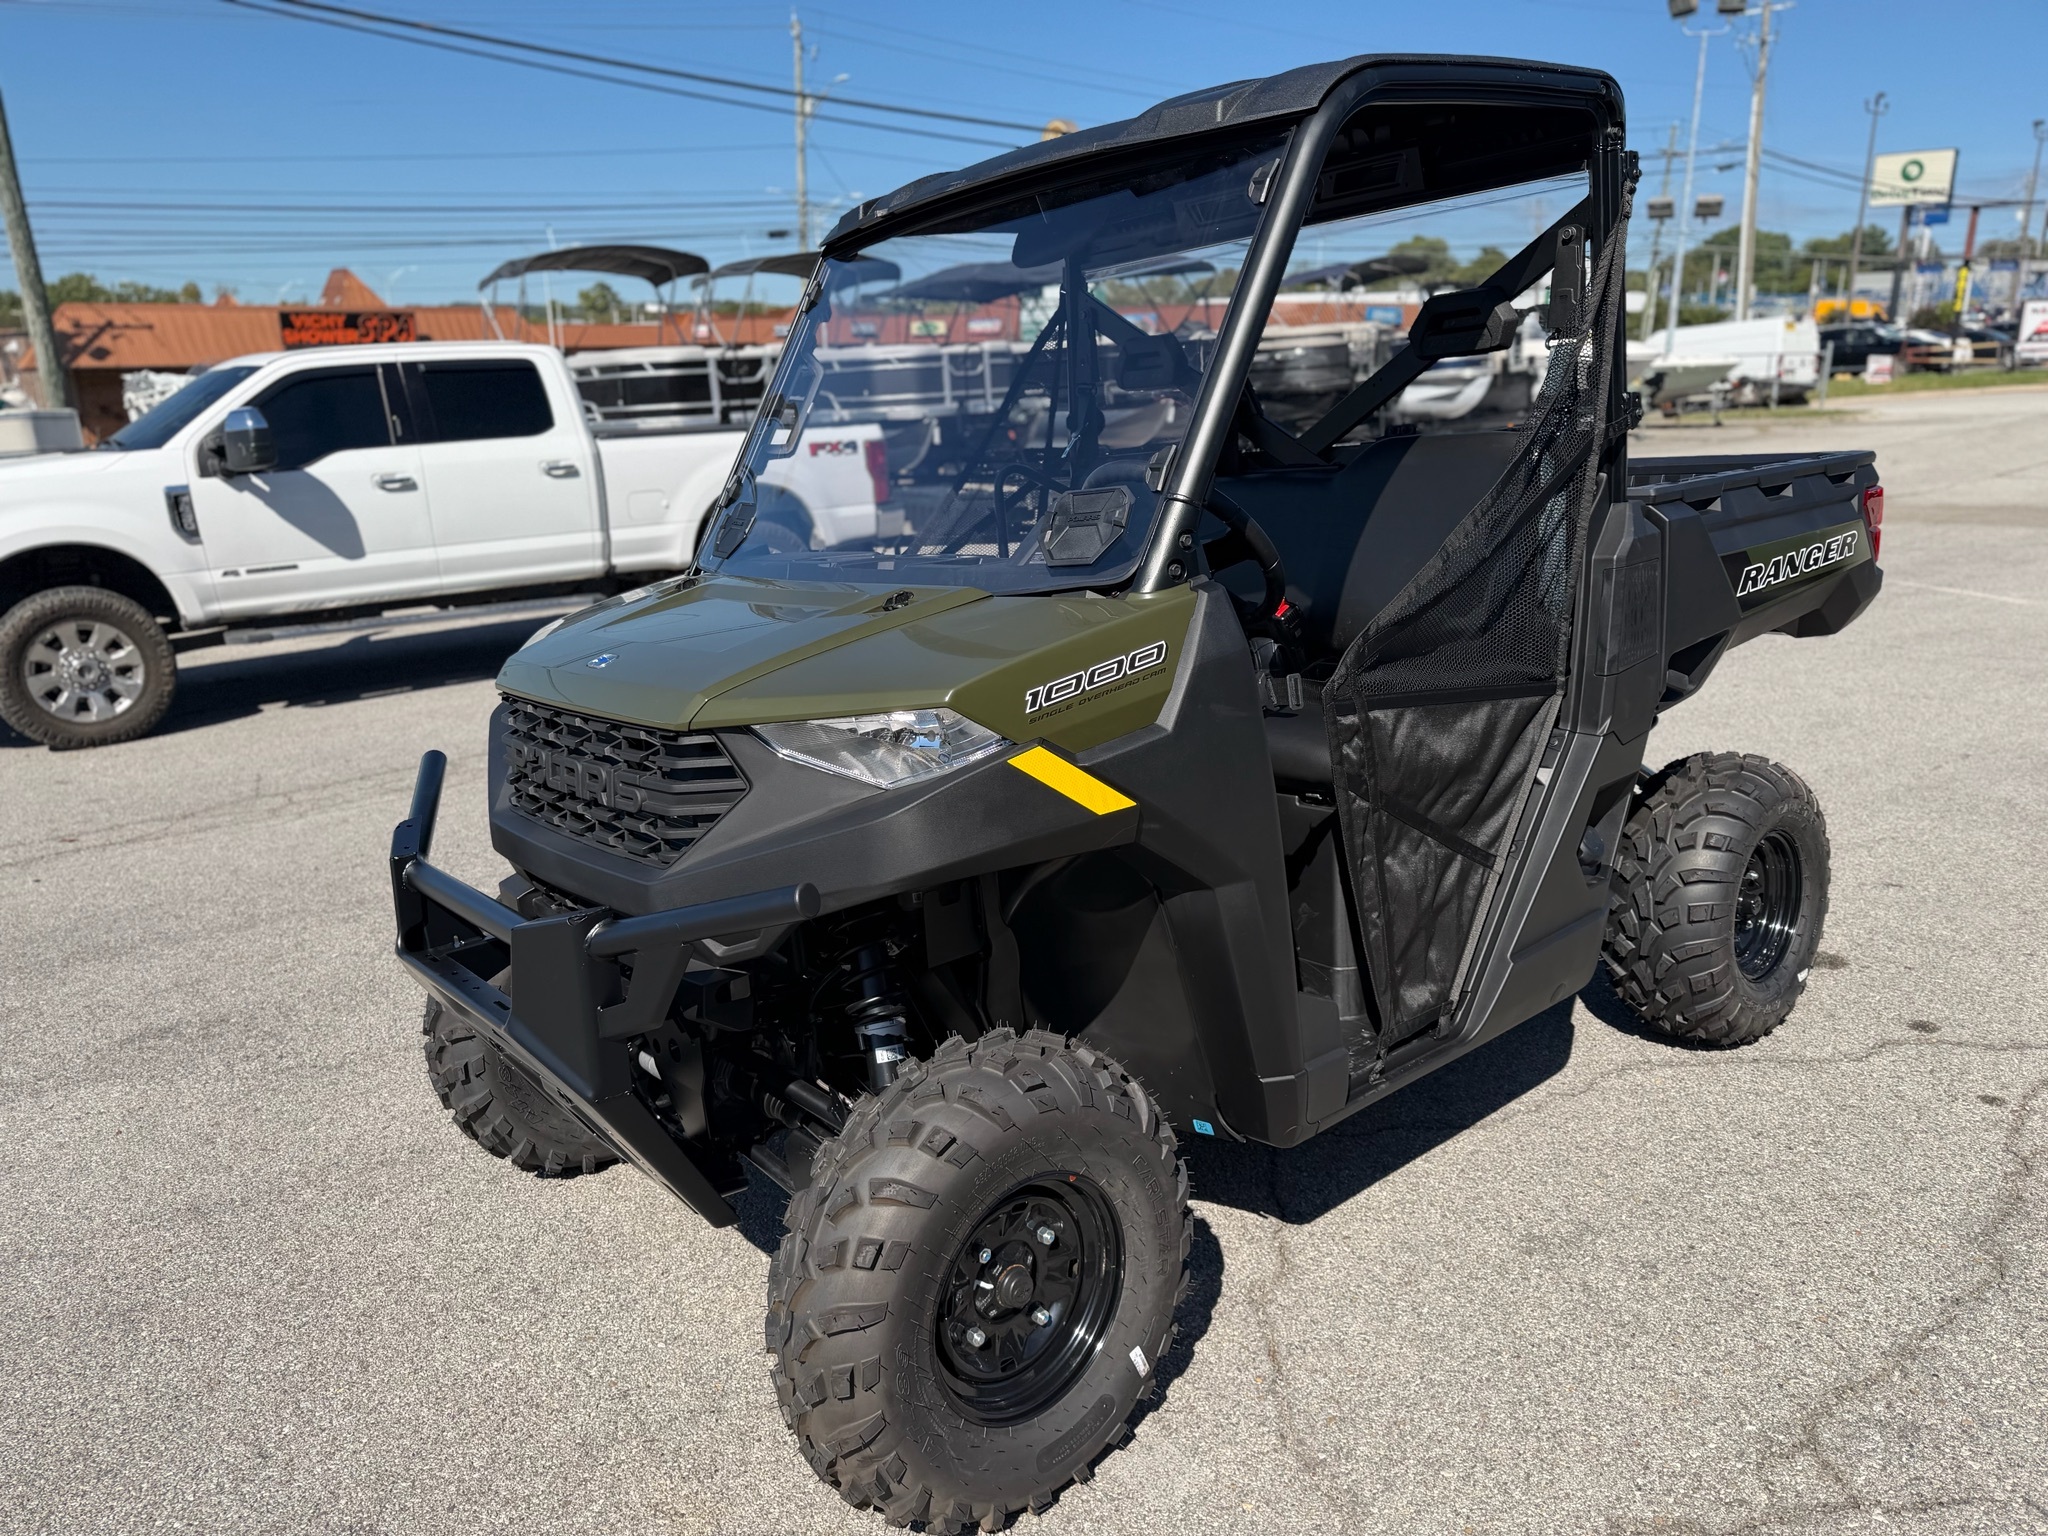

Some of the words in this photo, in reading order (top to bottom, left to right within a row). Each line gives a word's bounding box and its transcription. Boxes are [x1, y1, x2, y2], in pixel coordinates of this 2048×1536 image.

[357, 312, 416, 343] SPA
[809, 440, 858, 457] FX4
[1736, 530, 1858, 597] RANGER
[1025, 640, 1168, 714] 1000
[1028, 703, 1074, 725] SINGLE
[1078, 678, 1140, 706] OVERHEAD
[1142, 667, 1167, 681] CAM
[506, 735, 648, 813] POLARIS
[1132, 1154, 1171, 1277] CARLSTAR
